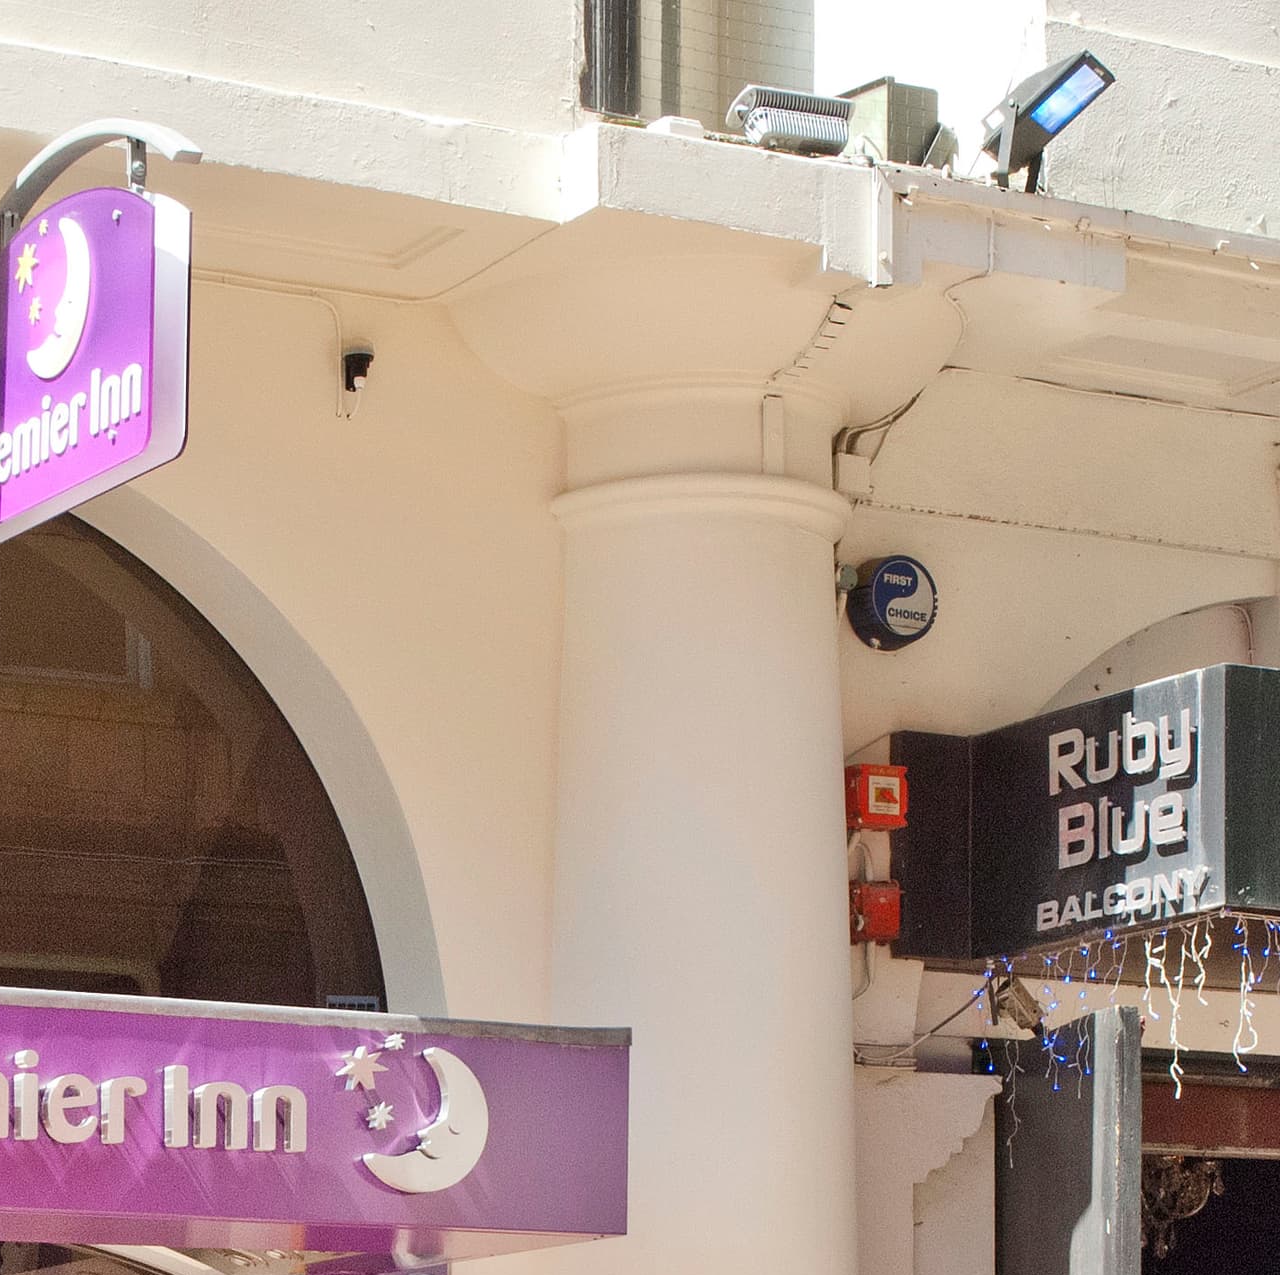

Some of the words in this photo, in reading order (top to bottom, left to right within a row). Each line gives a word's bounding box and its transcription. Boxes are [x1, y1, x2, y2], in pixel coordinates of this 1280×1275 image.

[89, 363, 143, 436] Inn
[883, 573, 913, 587] FIRST
[887, 607, 927, 622] CHOICE
[1048, 708, 1191, 796] Ruby
[1058, 791, 1187, 870] Blue
[1036, 863, 1209, 932] BALCONY
[163, 1064, 308, 1153] Inn
